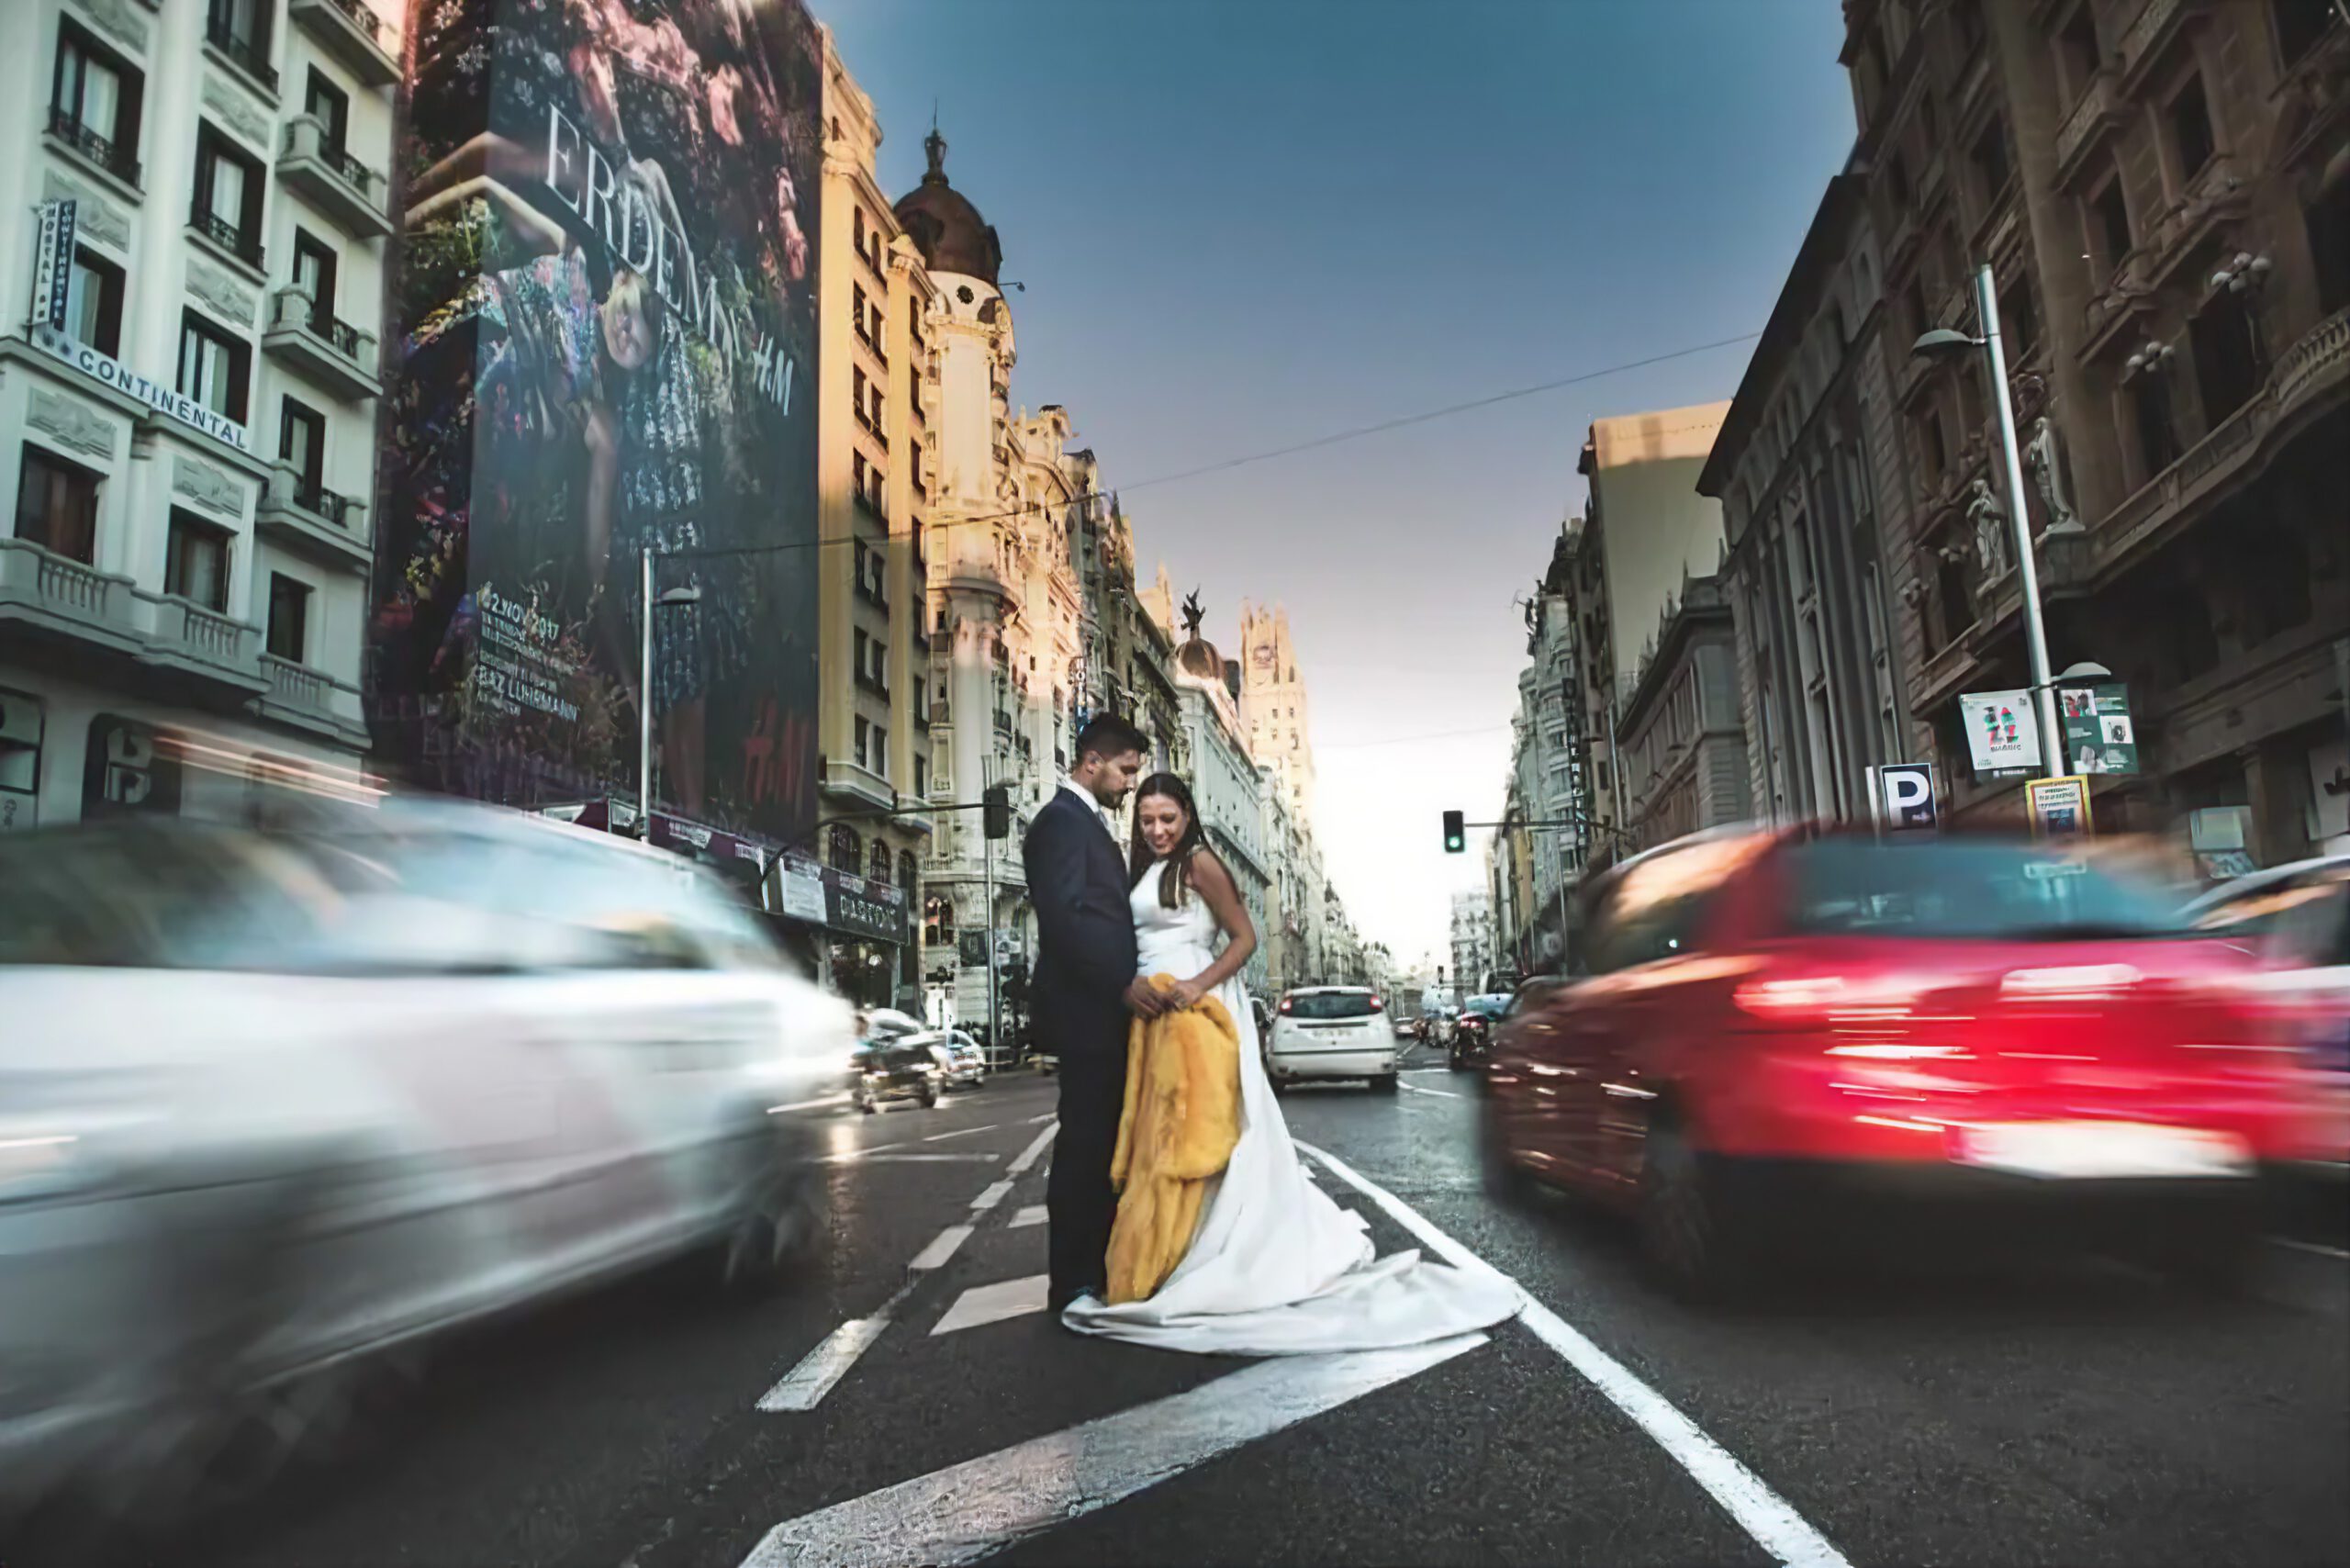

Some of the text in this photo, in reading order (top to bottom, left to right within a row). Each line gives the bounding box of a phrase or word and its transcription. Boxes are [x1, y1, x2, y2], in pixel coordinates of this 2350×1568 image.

[545, 102, 717, 343] ERDEM
[79, 350, 247, 450] CONTINENTAL
[1884, 771, 1930, 828] P
